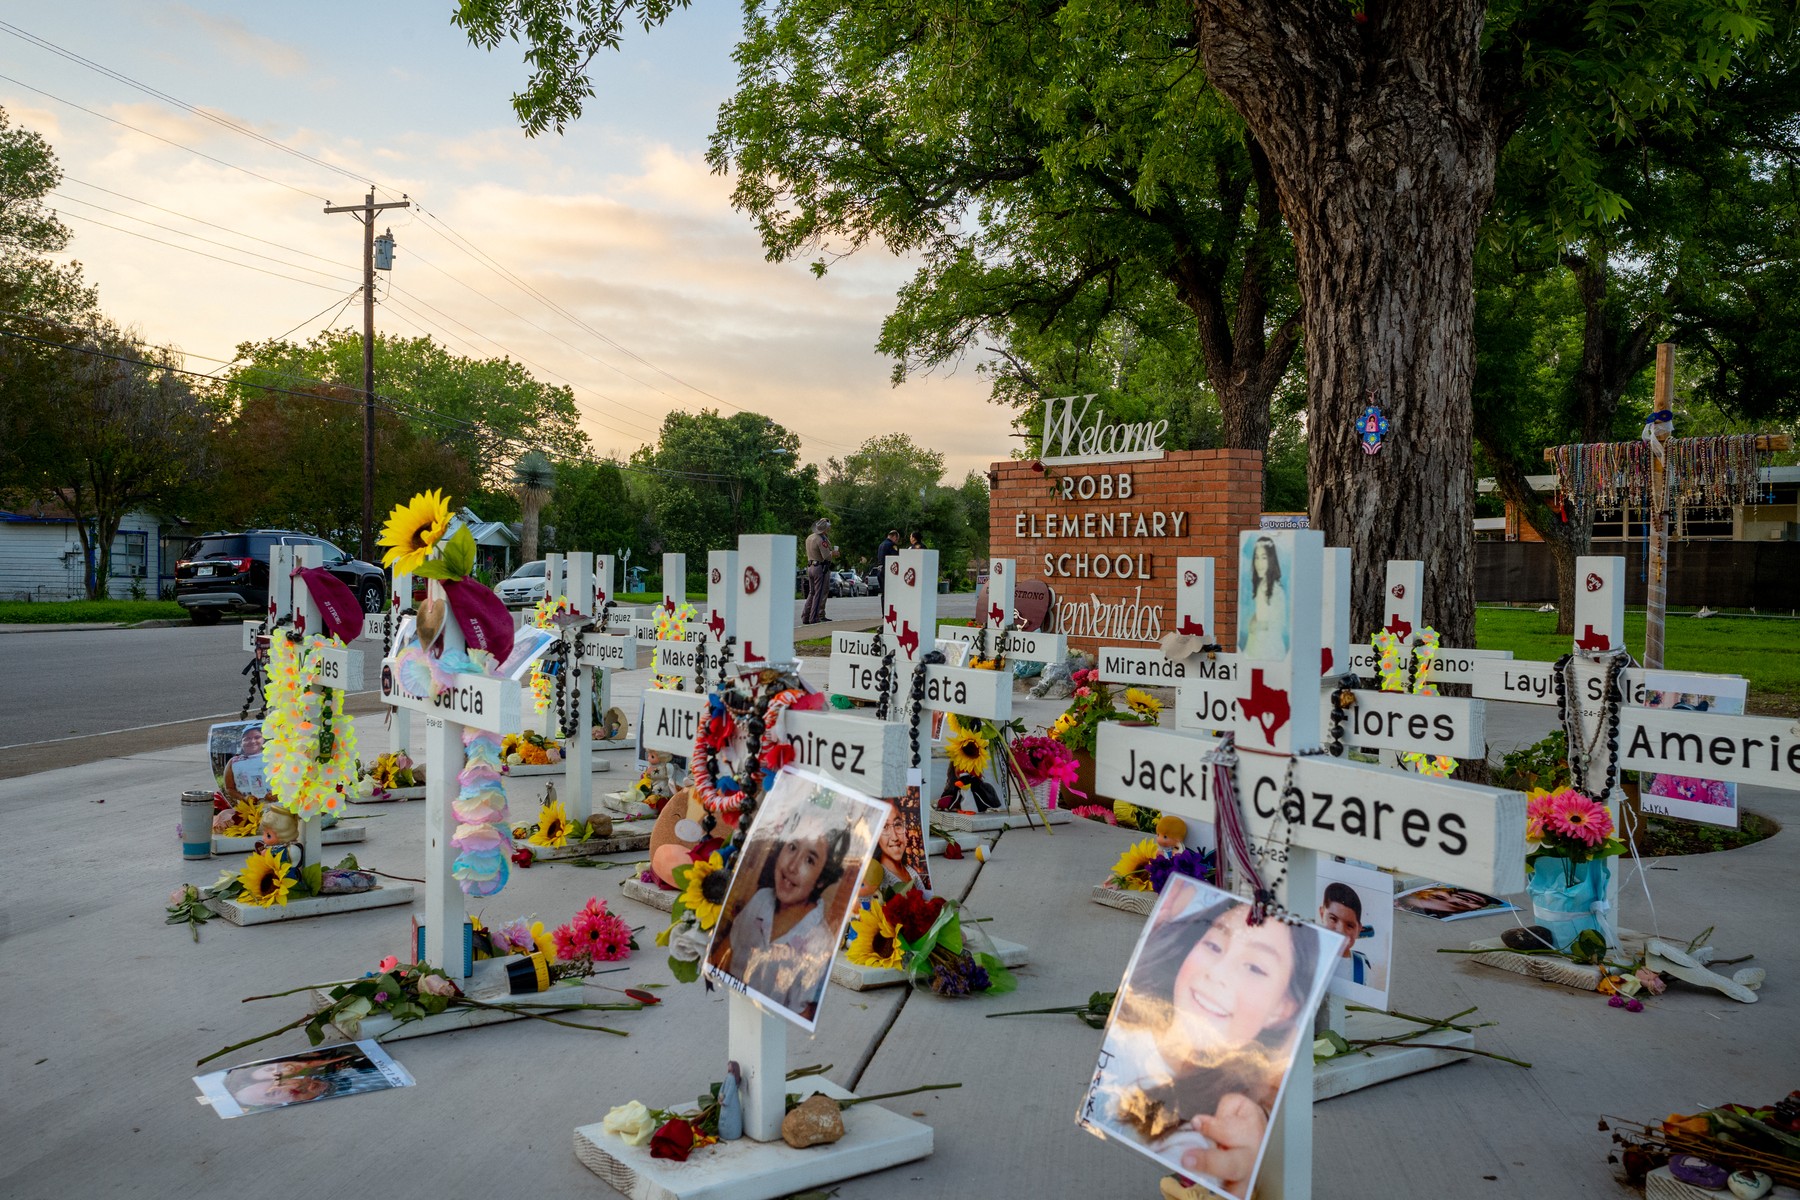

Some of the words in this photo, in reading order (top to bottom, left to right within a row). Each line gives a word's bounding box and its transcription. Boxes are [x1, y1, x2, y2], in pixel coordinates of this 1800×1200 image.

[1042, 393, 1169, 459] Welcome
[1062, 473, 1133, 501] ROBB
[1015, 511, 1187, 538] ELEMENTARY
[1043, 552, 1152, 581] SCHOOL
[1014, 589, 1045, 601] STRONG
[597, 611, 631, 623] Rdriguez
[662, 648, 718, 670] Makena
[1105, 656, 1186, 678] Miranda
[849, 663, 899, 694] Tess
[1343, 706, 1455, 742] lores
[1253, 775, 1468, 856] Cazares
